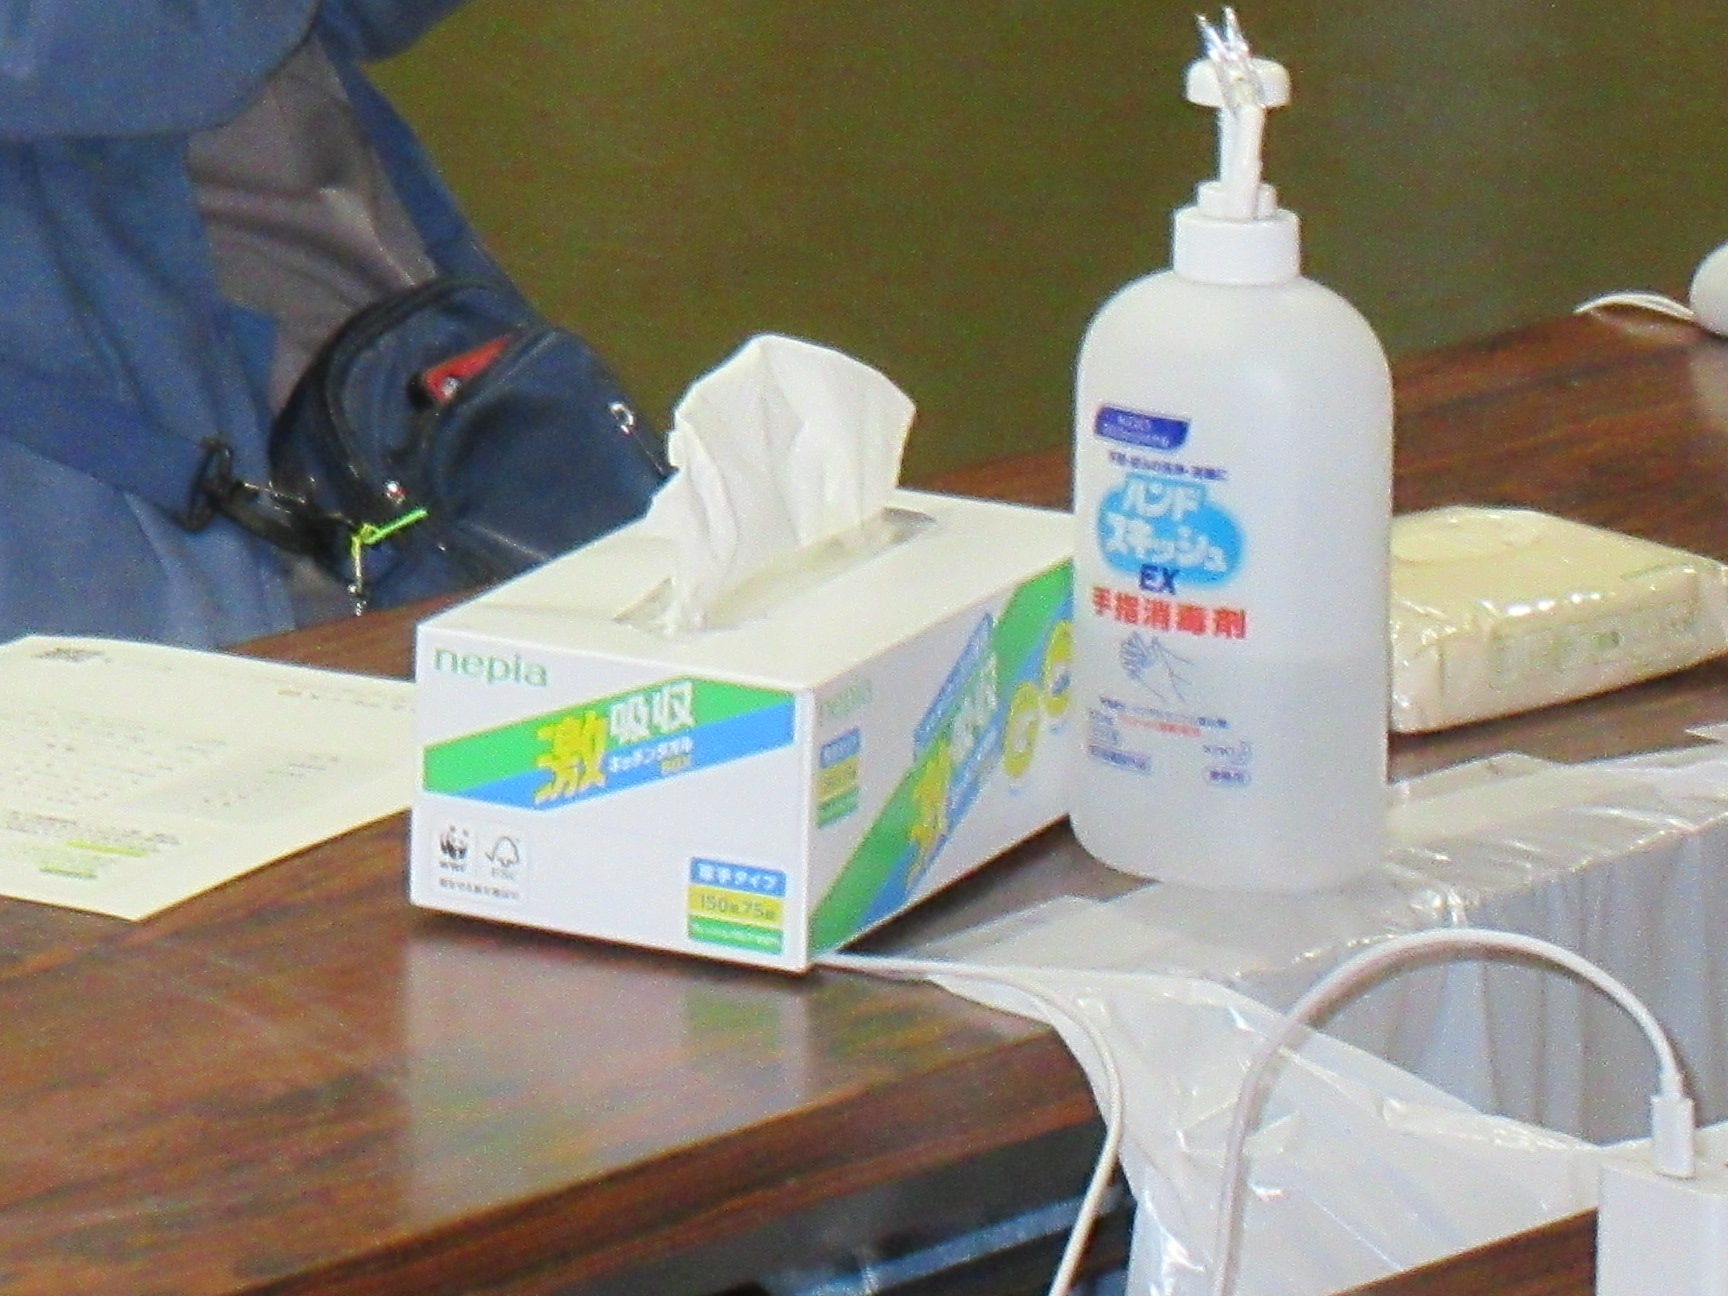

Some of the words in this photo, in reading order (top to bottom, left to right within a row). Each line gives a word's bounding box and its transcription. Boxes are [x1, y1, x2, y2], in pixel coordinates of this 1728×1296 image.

[1121, 479, 1201, 521] ハンド
[1106, 512, 1229, 573] スキッシュ
[1139, 563, 1180, 596] EX
[1091, 585, 1247, 640] 手指消毒剤
[433, 647, 549, 687] nepia
